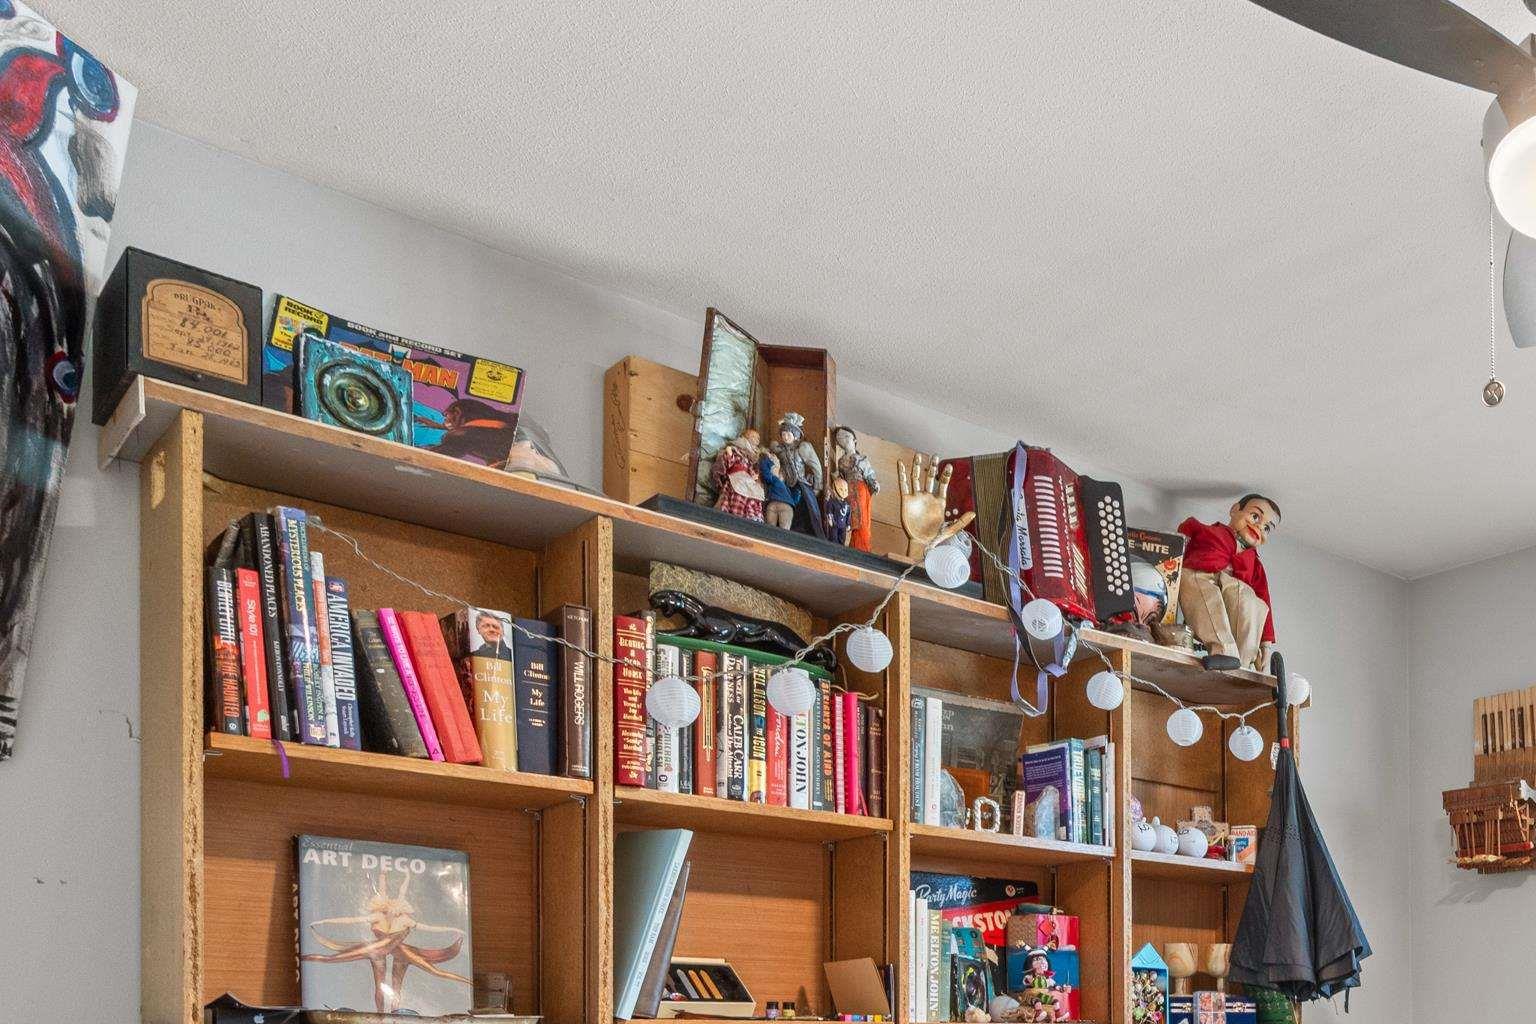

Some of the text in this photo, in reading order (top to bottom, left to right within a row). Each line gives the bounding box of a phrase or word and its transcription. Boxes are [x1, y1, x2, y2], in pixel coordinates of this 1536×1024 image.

[285, 306, 324, 325] RECORD
[286, 300, 313, 316] BOOK
[347, 321, 464, 359] BOOK and RECORD SET
[402, 359, 459, 390] MAN
[1142, 541, 1169, 555] NITE
[259, 523, 278, 618] ABANDONED PLACES
[287, 518, 307, 612] MYSTERIOUS PLACES
[246, 600, 257, 625] Style
[327, 592, 356, 701] AMERICA INVADED
[475, 672, 513, 685] Clinton
[523, 670, 548, 681] Clinton
[530, 661, 545, 671] Bill
[221, 660, 240, 718] THE HAUNTED
[483, 690, 508, 710] My
[530, 688, 543, 699] My
[573, 660, 585, 726] WILL ROGERS
[304, 684, 316, 722] WILKINSON
[529, 697, 545, 708] Life
[752, 689, 766, 717] OLSON
[480, 708, 513, 724] Life
[732, 714, 745, 778] CALEB CARR
[752, 735, 766, 761] ICON
[822, 732, 832, 748] OF
[795, 749, 807, 793] JOHN
[823, 749, 833, 777] MIND
[303, 848, 426, 874] ART DECO
[915, 883, 978, 907] Party Magic
[929, 934, 940, 975] ELTON
[928, 975, 940, 1012] JOHN
